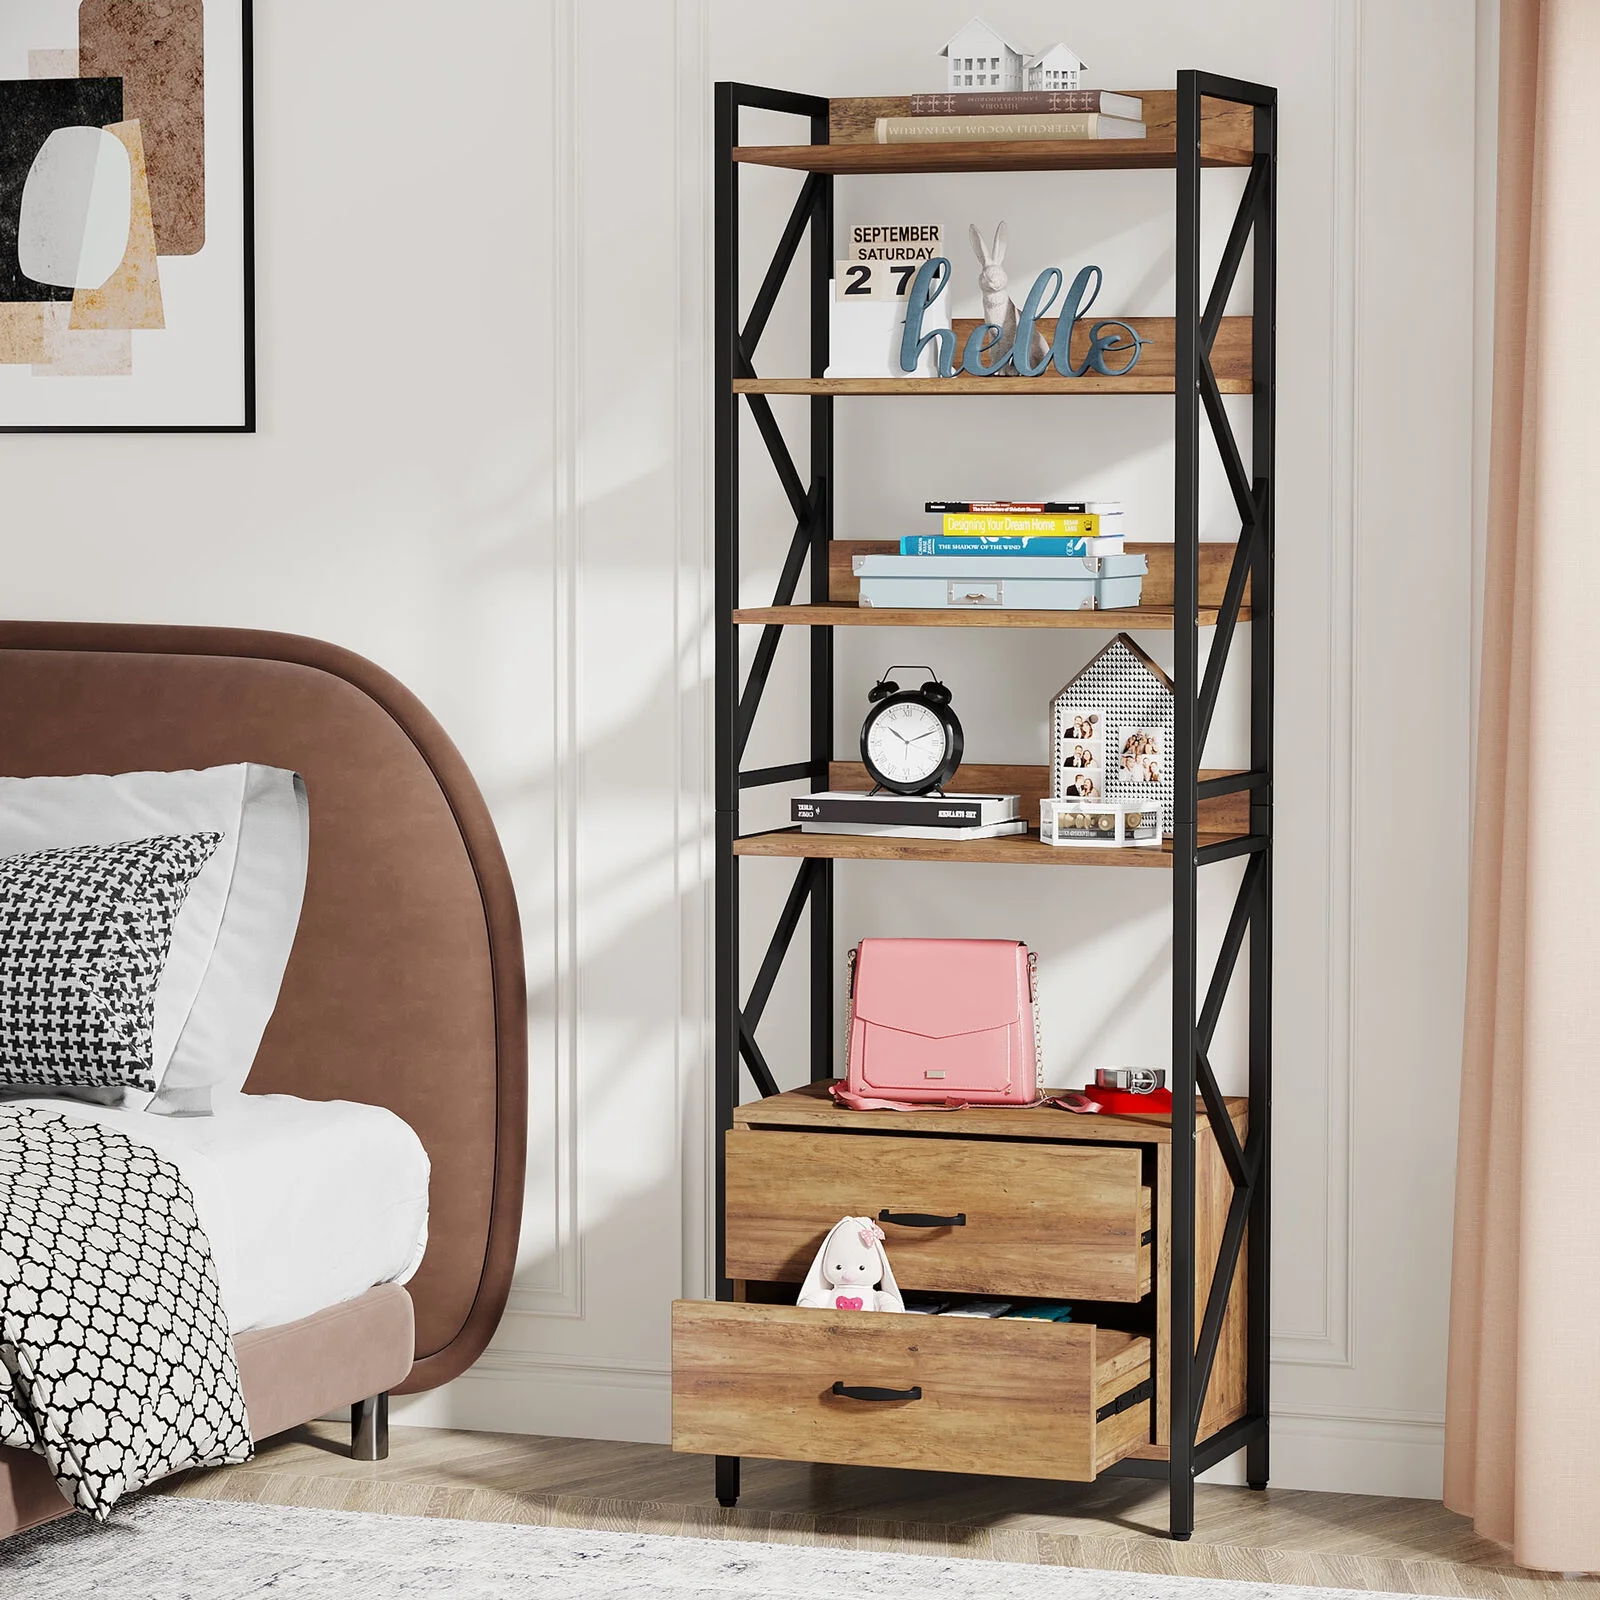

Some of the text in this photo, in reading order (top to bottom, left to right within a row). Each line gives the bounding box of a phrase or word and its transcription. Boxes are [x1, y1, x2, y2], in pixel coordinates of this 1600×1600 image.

[888, 124, 1085, 135] LATERCULI VOCUM LATINARUM
[853, 226, 939, 243] SEPTEMBER
[858, 247, 935, 260] SATURDAY
[844, 265, 916, 295] 2 7
[900, 257, 1153, 378] hello
[948, 517, 1055, 534] Designing Your Dream Home
